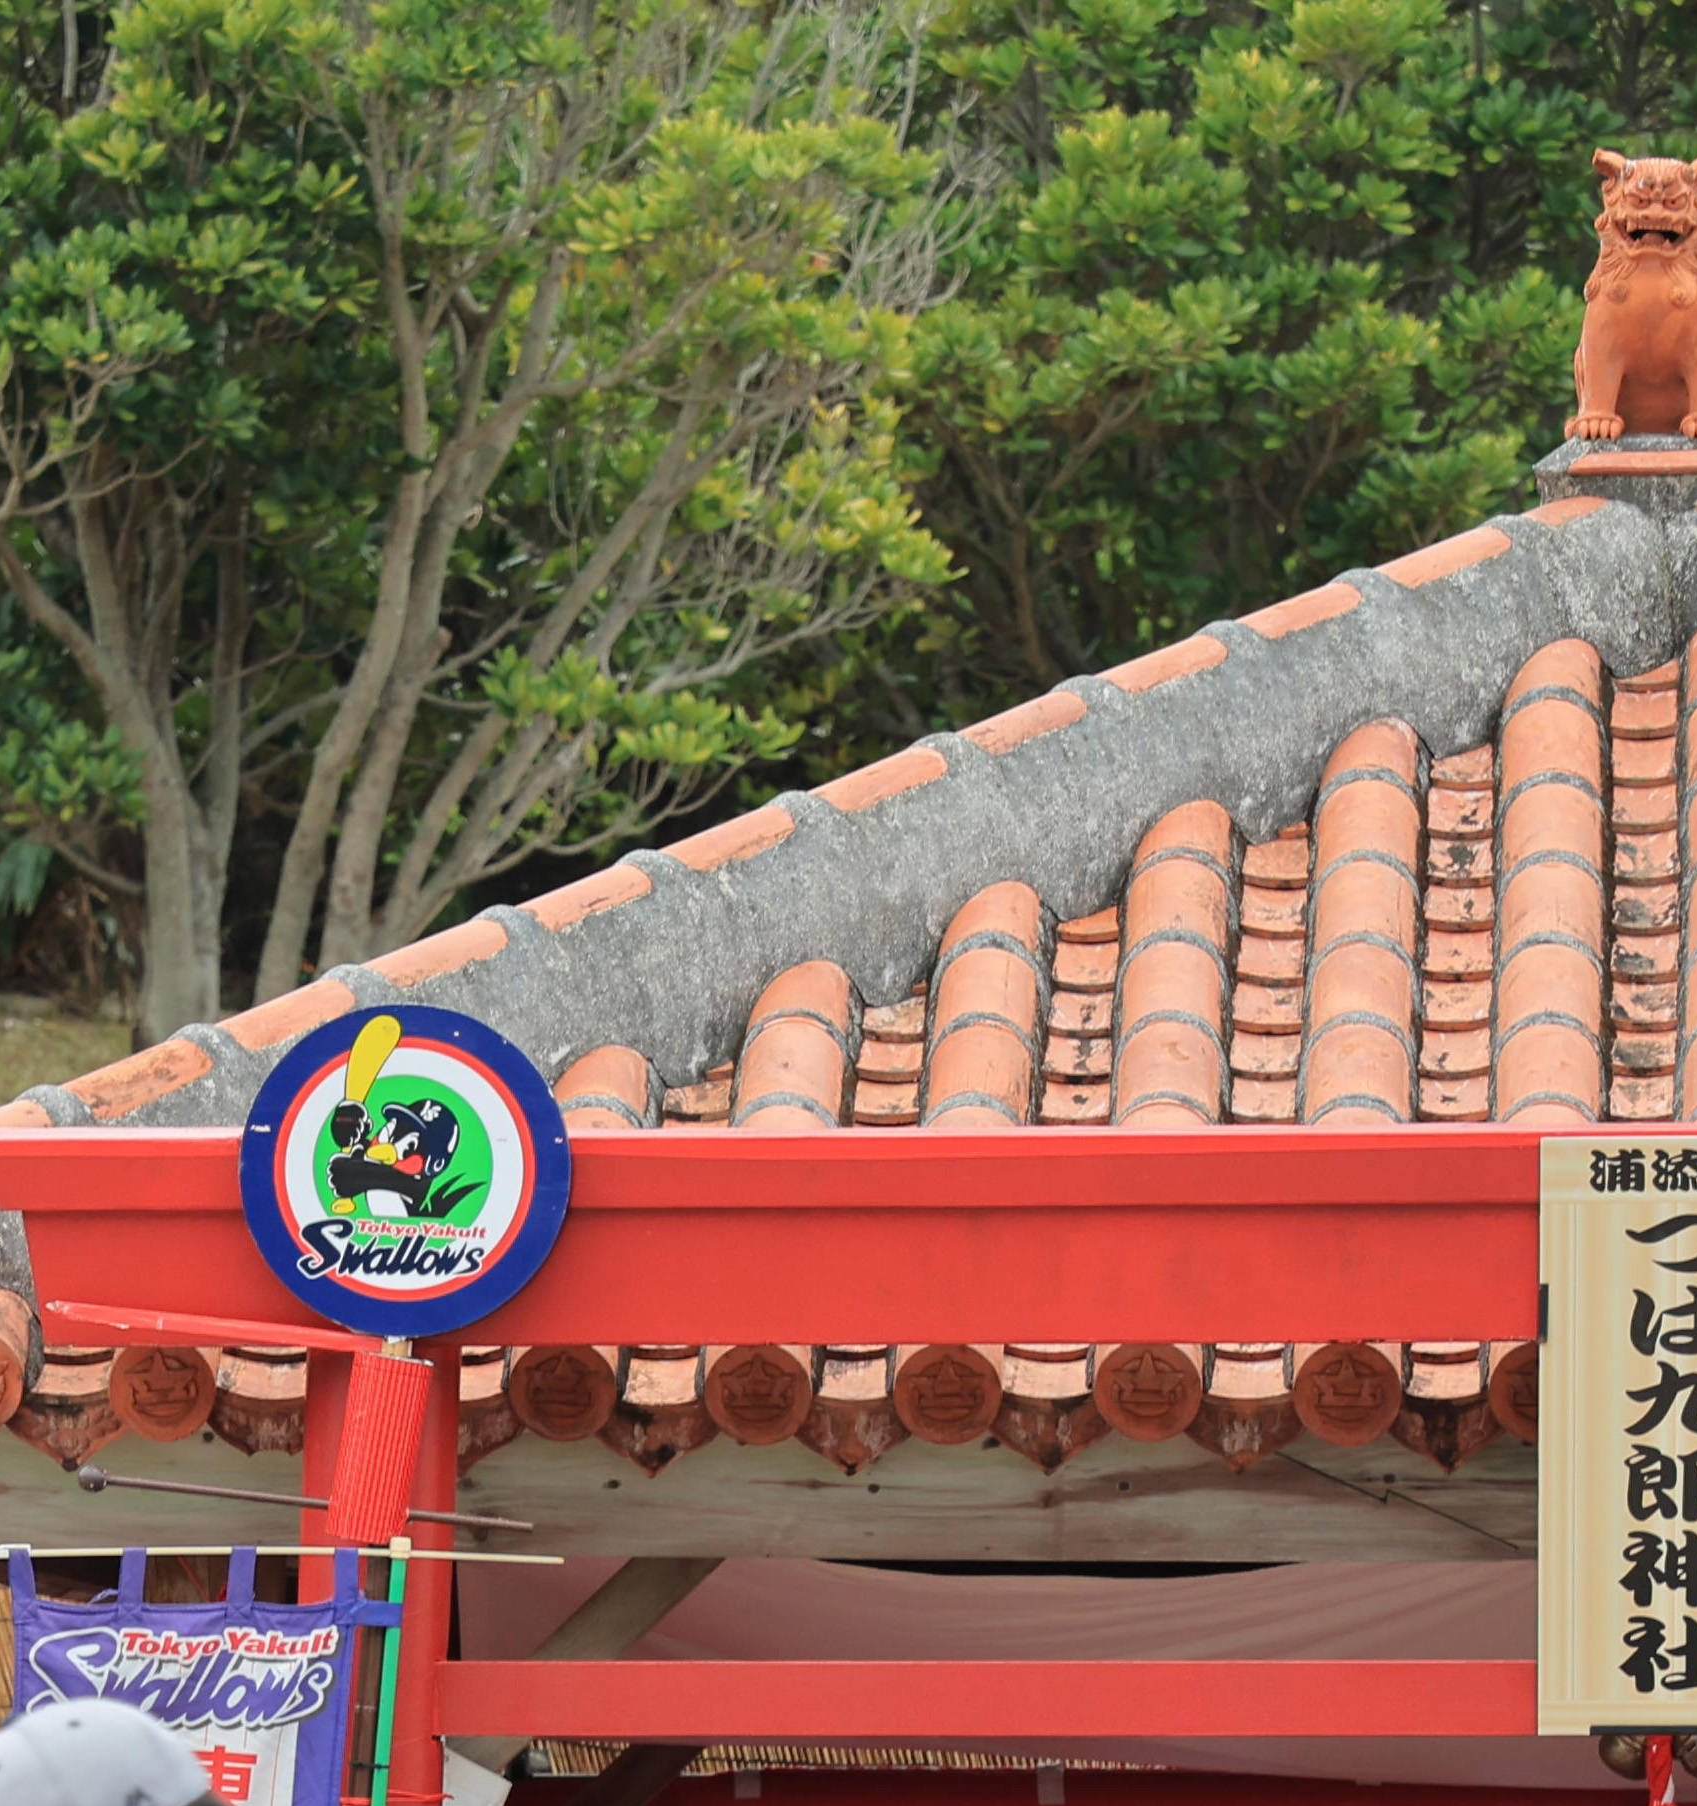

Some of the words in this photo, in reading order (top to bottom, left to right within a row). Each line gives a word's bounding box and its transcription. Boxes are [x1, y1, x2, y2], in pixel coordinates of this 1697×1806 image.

[298, 1220, 486, 1279] Swallows
[357, 1220, 419, 1238] Tokyo
[420, 1222, 488, 1239] Yakult
[121, 1631, 222, 1660] Tokyo
[224, 1626, 338, 1658] Yakult
[28, 1628, 332, 1726] Swallows
